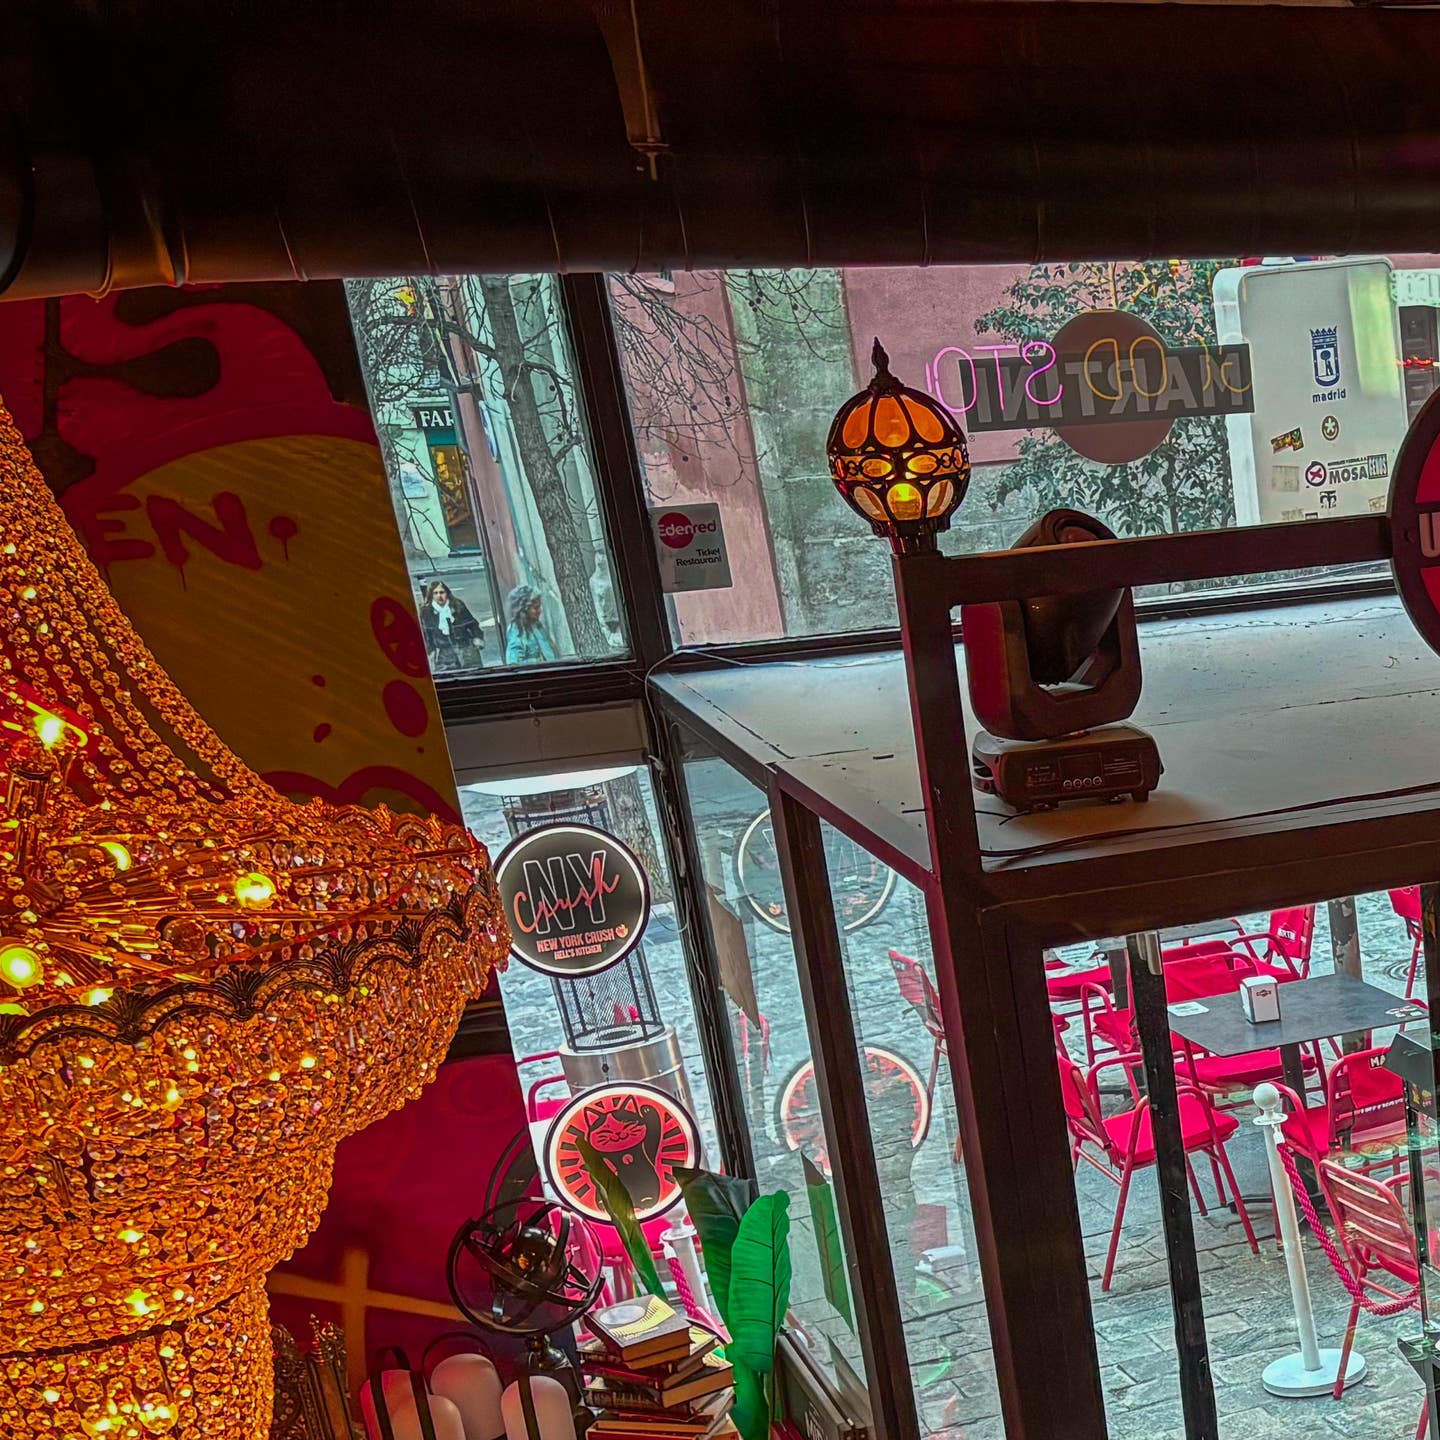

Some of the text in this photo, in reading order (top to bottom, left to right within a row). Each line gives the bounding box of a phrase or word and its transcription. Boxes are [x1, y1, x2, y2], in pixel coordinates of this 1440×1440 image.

[1312, 388, 1347, 403] madrid
[658, 519, 717, 537] Edenred
[696, 547, 721, 557] Ticket
[676, 556, 722, 567] Restaurant
[536, 928, 615, 953] NEW YORK CRUSH
